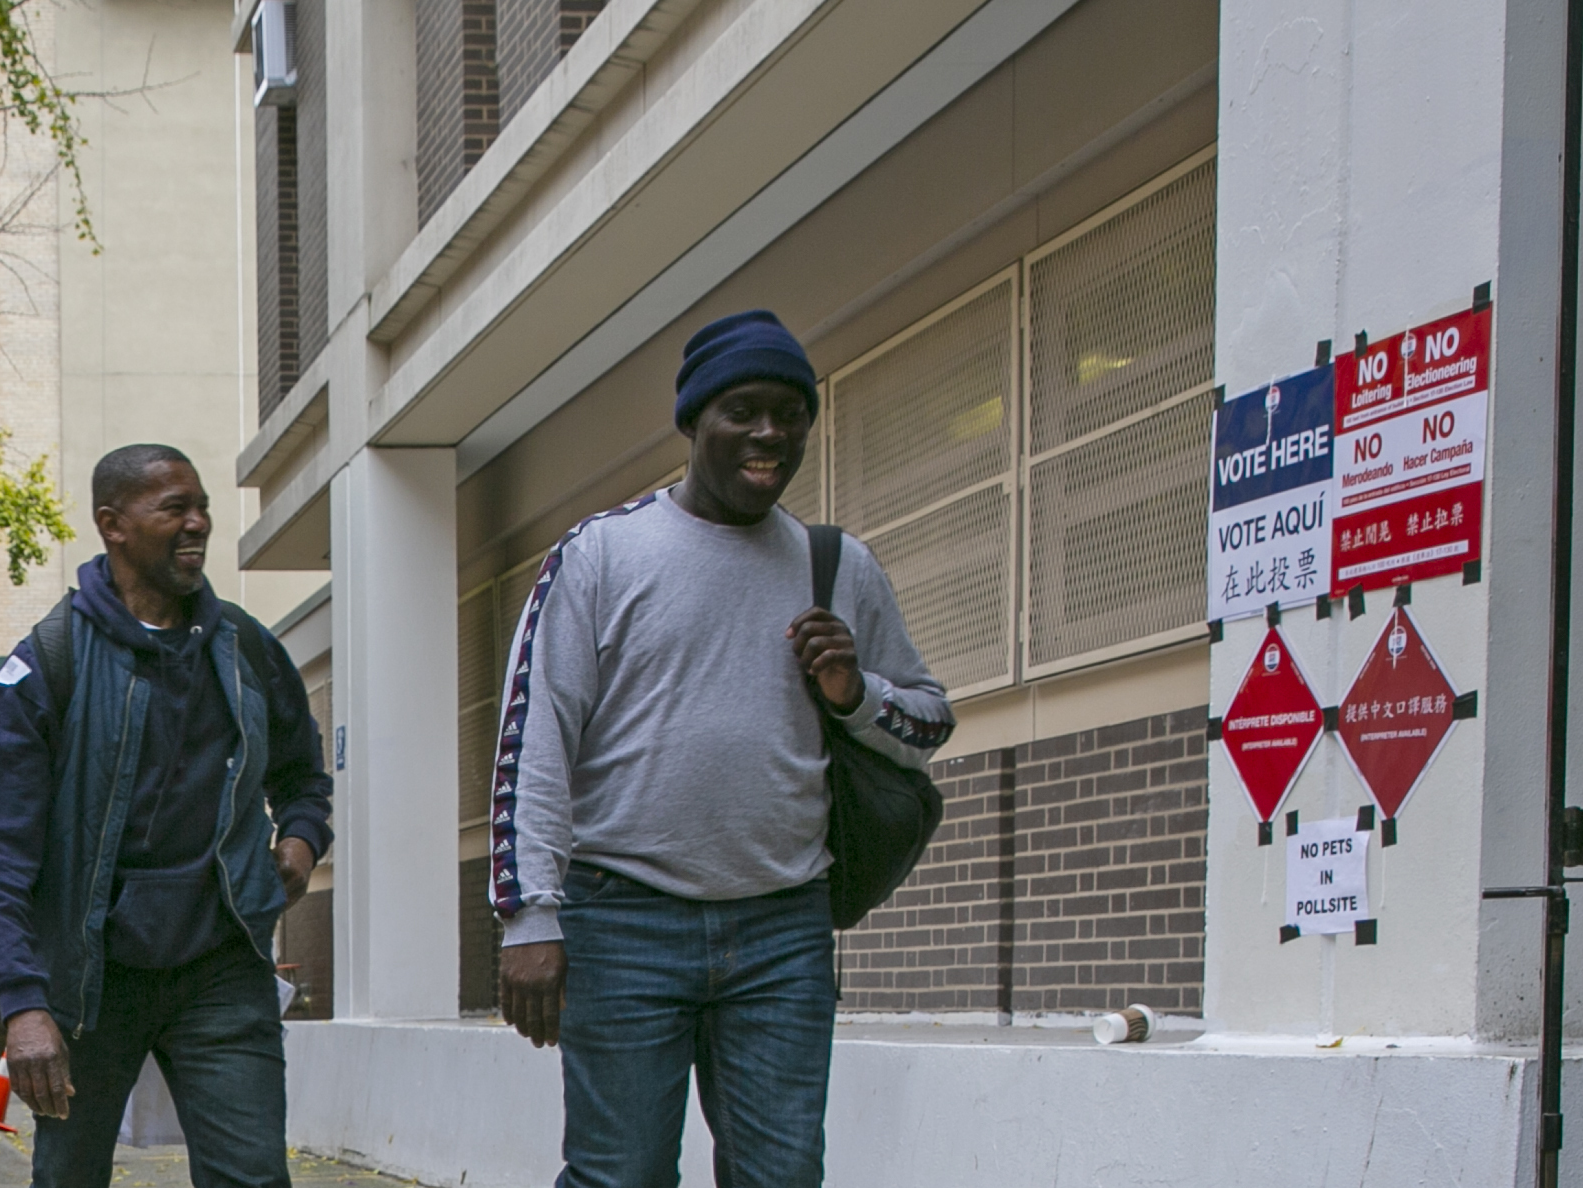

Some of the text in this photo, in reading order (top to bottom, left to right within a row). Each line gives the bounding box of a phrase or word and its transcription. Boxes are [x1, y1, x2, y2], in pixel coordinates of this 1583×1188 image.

[1425, 327, 1460, 363] NO
[1358, 351, 1388, 386] NO
[1406, 356, 1477, 389] Electioneering
[1352, 383, 1392, 409] Loitering
[1422, 410, 1455, 444] NO
[1218, 424, 1330, 486] VOTE HERE
[1354, 433, 1382, 464] NO
[1403, 439, 1473, 471] Hacer Campaña
[1342, 462, 1393, 489] Merodeando
[1219, 490, 1326, 553] VOTE AQUÍ
[1220, 547, 1318, 604] 在此投票
[1270, 709, 1315, 727] DISPONIBLE
[1300, 838, 1353, 859] NO PETS
[1320, 869, 1333, 885] IN
[1296, 896, 1358, 916] POLLSITE
